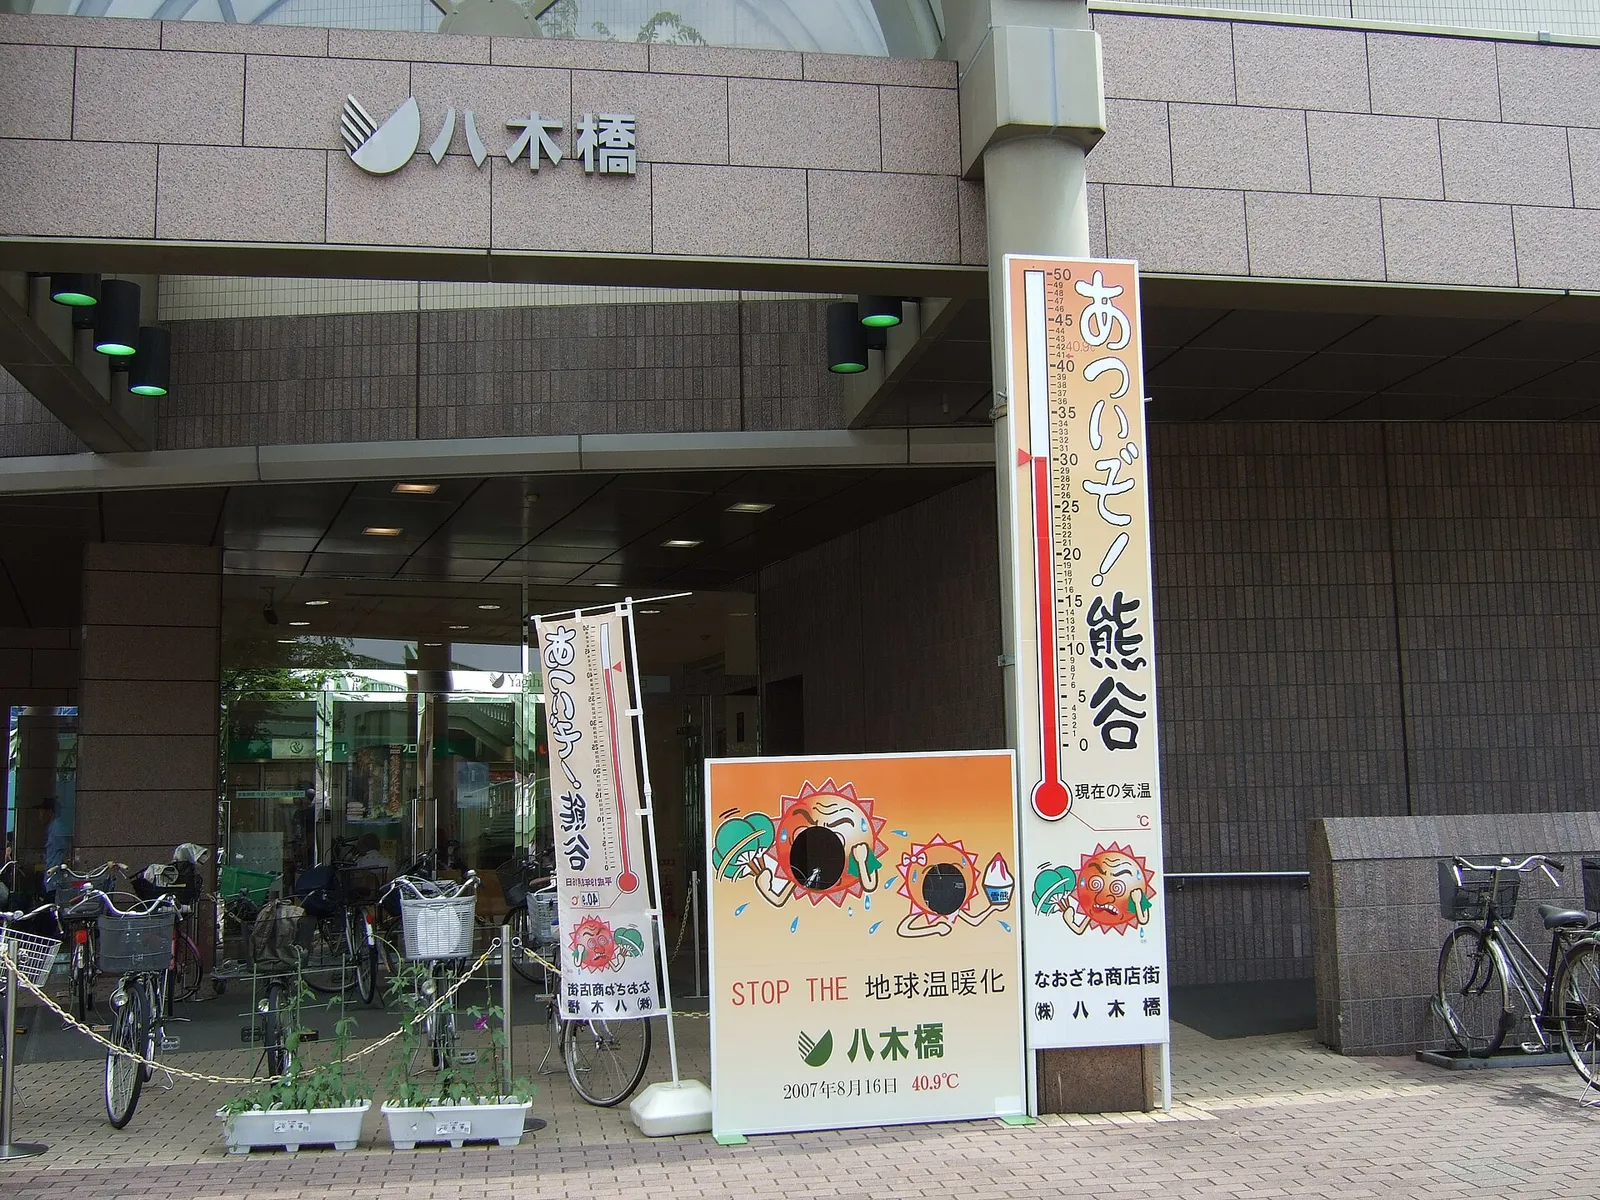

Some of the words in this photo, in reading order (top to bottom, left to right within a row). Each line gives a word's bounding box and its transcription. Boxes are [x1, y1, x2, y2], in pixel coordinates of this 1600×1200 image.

[429, 107, 636, 175] 八木橋
[1054, 269, 1071, 280] 50
[1055, 314, 1072, 326] 45
[1057, 360, 1074, 372] 40
[1059, 407, 1076, 418] 35
[1060, 453, 1078, 465] 30
[1062, 500, 1079, 513] 25
[1064, 548, 1081, 560] 20
[1066, 595, 1082, 607] 15
[1067, 642, 1084, 655] 10
[1078, 690, 1086, 703] 5
[1080, 738, 1088, 751] 0
[1075, 783, 1151, 800] 現在の気温
[1034, 966, 1160, 988] なおざね商店街
[732, 979, 789, 1006] STOP
[806, 976, 848, 1001] THE
[864, 968, 1005, 1000] 地球温暖化
[847, 1023, 944, 1063] 八木橋
[783, 1077, 898, 1100] 2007年8月16日
[911, 1072, 960, 1092] 40.9℃
